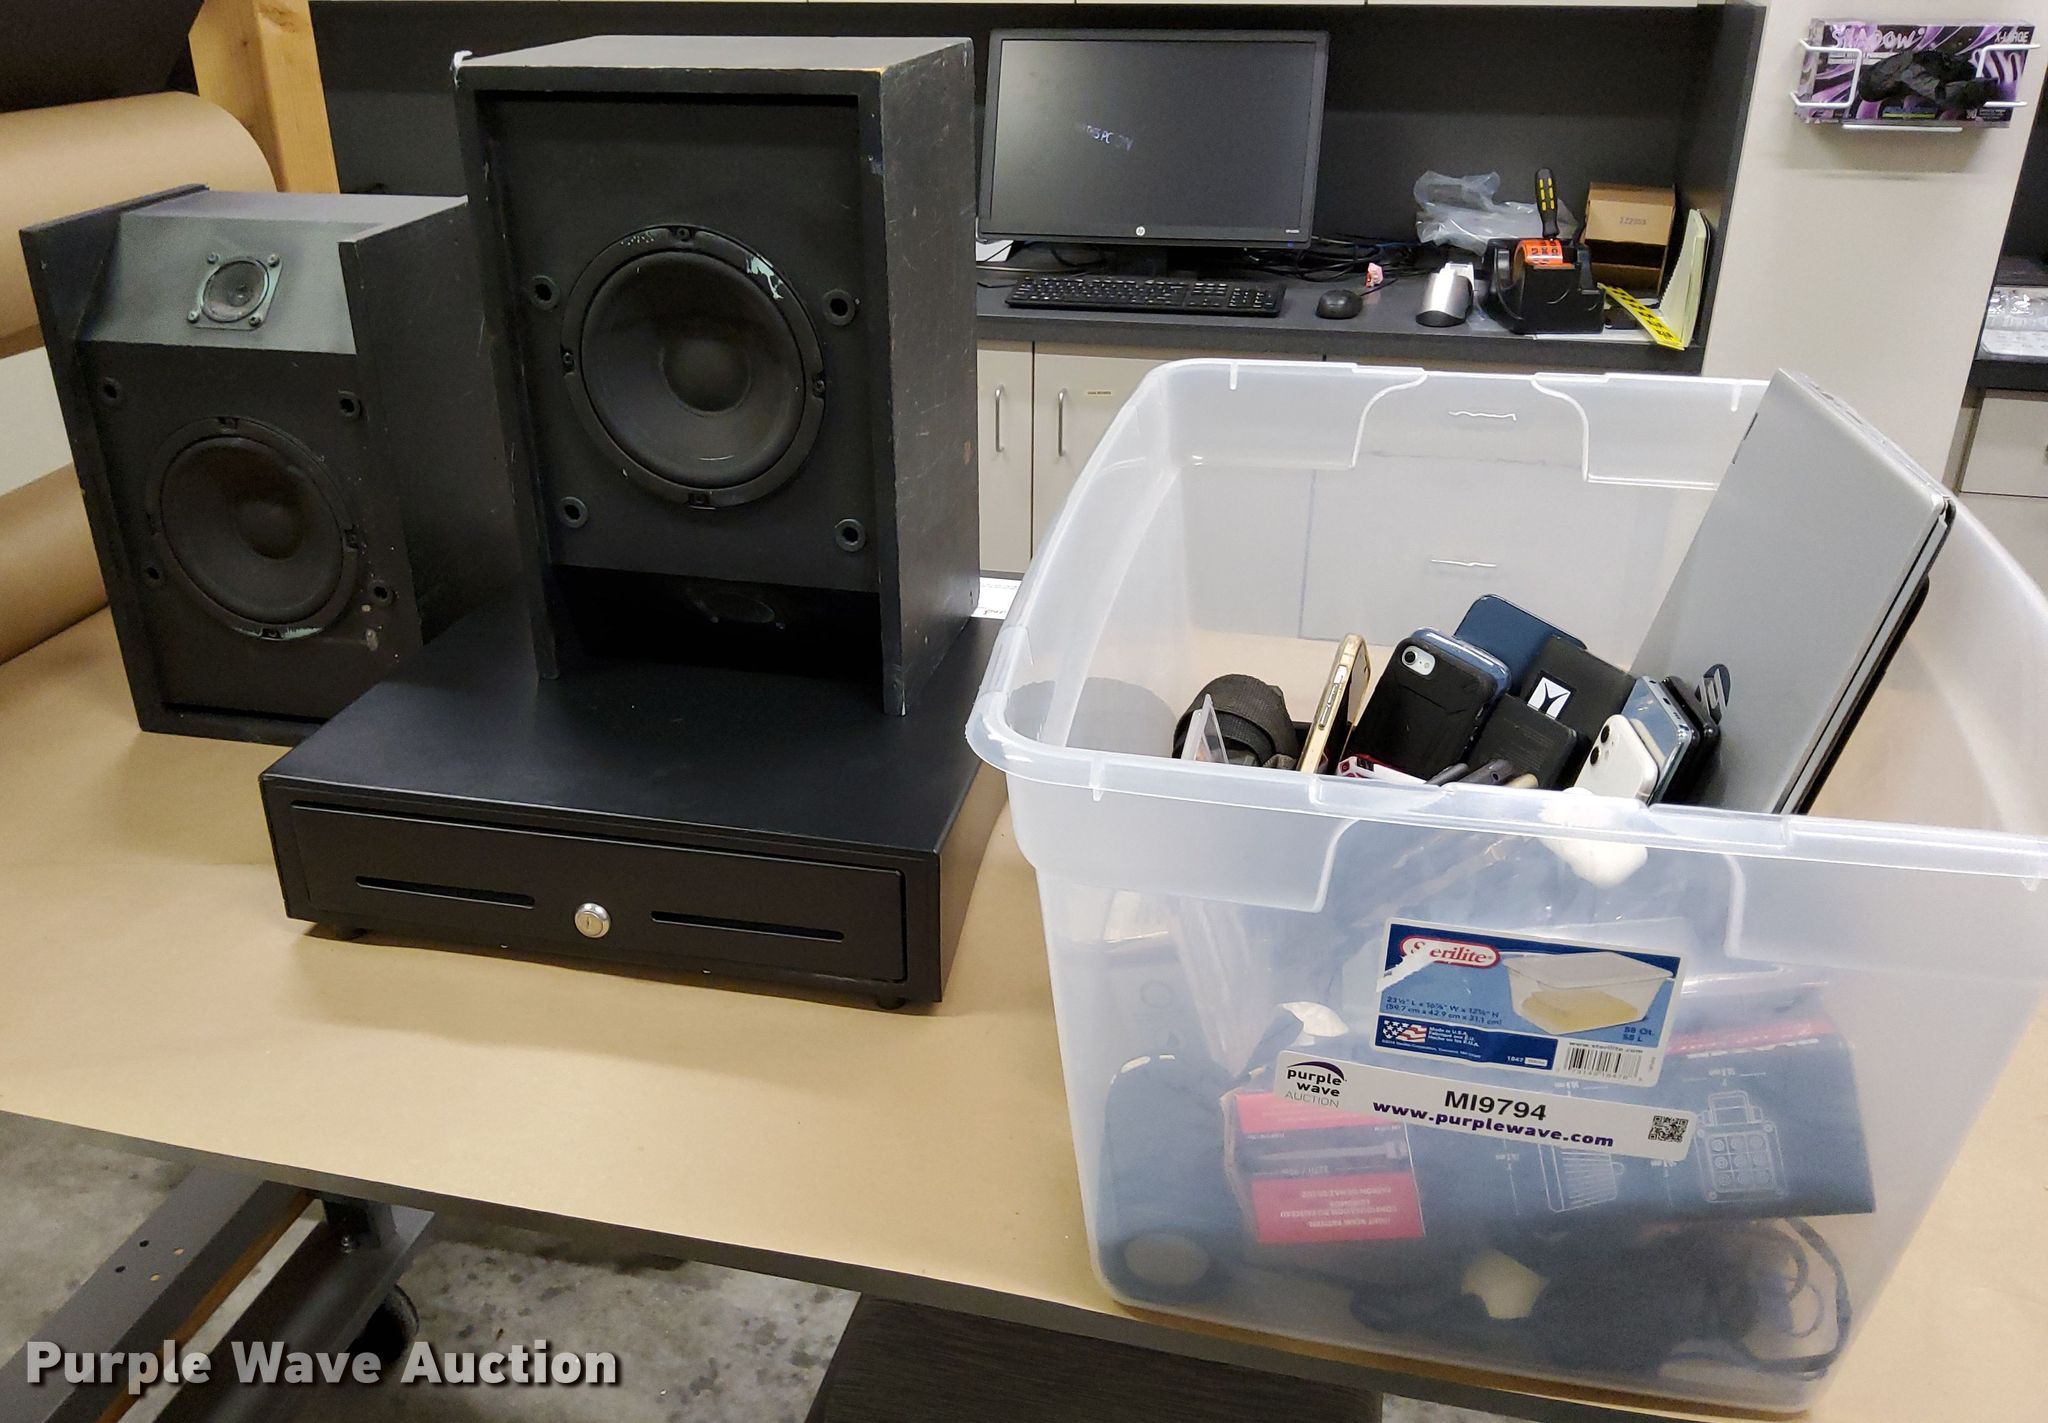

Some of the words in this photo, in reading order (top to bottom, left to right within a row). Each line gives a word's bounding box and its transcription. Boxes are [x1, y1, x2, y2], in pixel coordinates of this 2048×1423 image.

[1994, 31, 2029, 43] X-LARGE
[1411, 941, 1487, 964] Serilite
[1287, 1069, 1342, 1086] purple
[1297, 1082, 1340, 1097] wave
[1284, 1090, 1339, 1109] AUCTION
[1444, 1090, 1547, 1121] MI9794
[1373, 1101, 1613, 1148] www.purplewave.com
